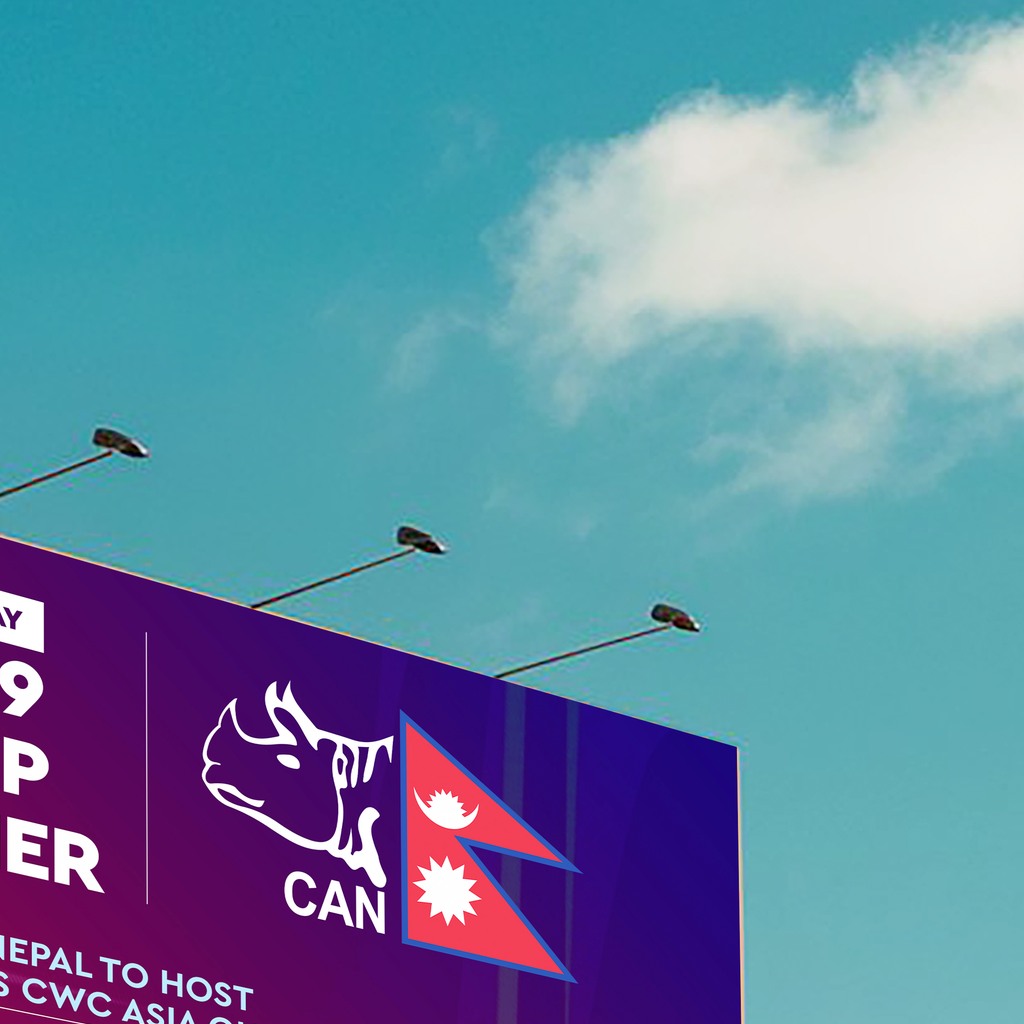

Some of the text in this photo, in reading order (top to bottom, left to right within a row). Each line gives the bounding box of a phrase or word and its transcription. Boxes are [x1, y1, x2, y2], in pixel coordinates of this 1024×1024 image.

[283, 870, 386, 934] CAN
[22, 977, 112, 1018] CWC
[99, 956, 149, 989] TO
[161, 970, 254, 1011] HOST
